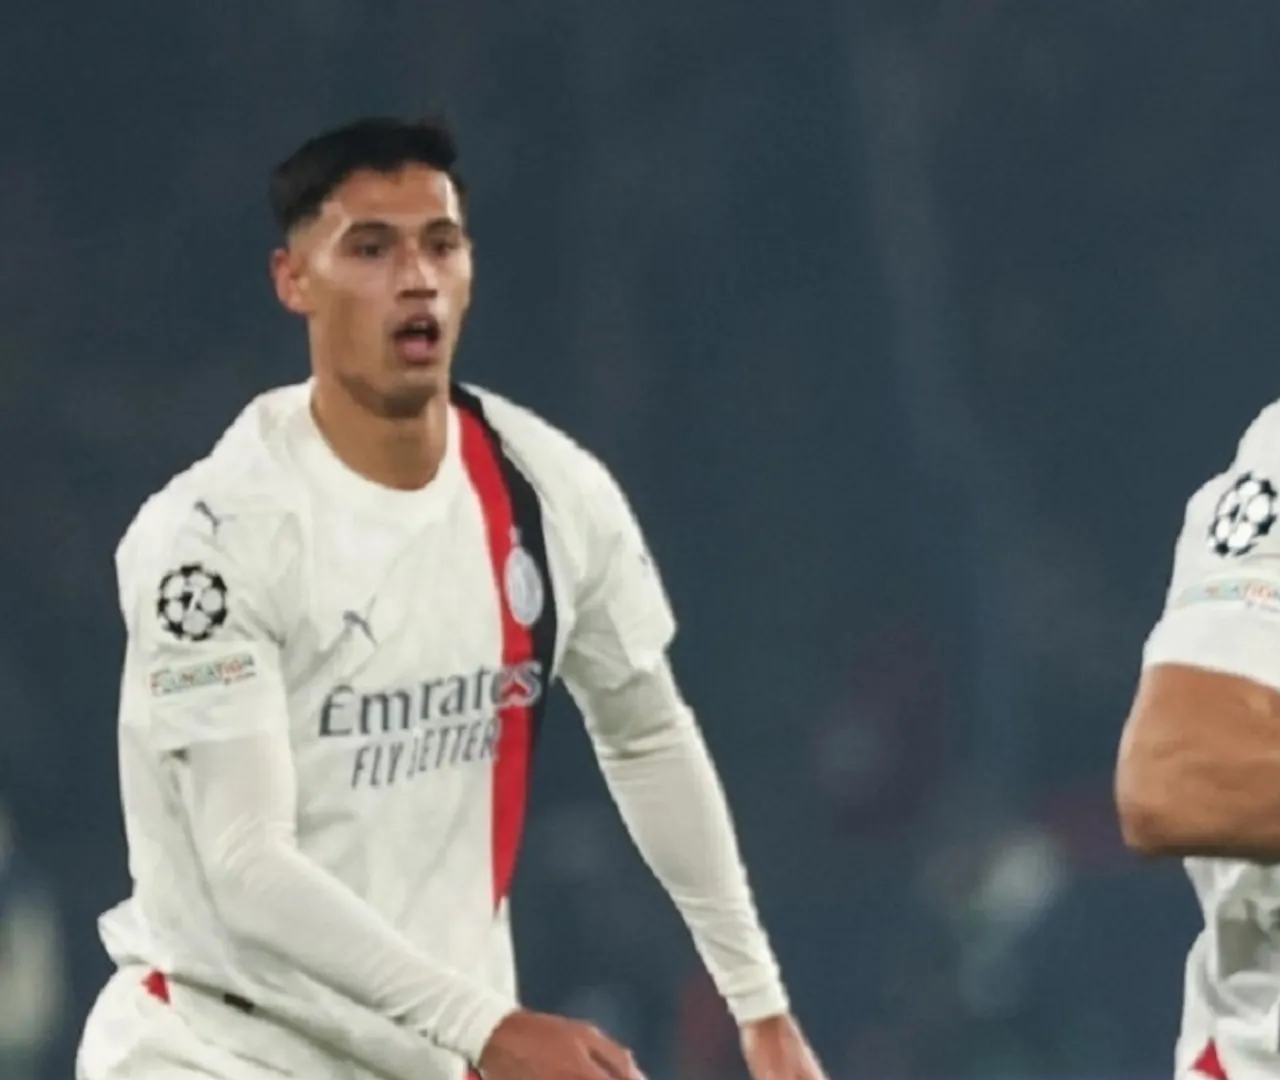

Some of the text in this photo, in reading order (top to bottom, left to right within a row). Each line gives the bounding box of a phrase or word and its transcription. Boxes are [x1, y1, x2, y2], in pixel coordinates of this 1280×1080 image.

[319, 660, 542, 737] Emrates
[351, 717, 502, 790] FLY ETTER
